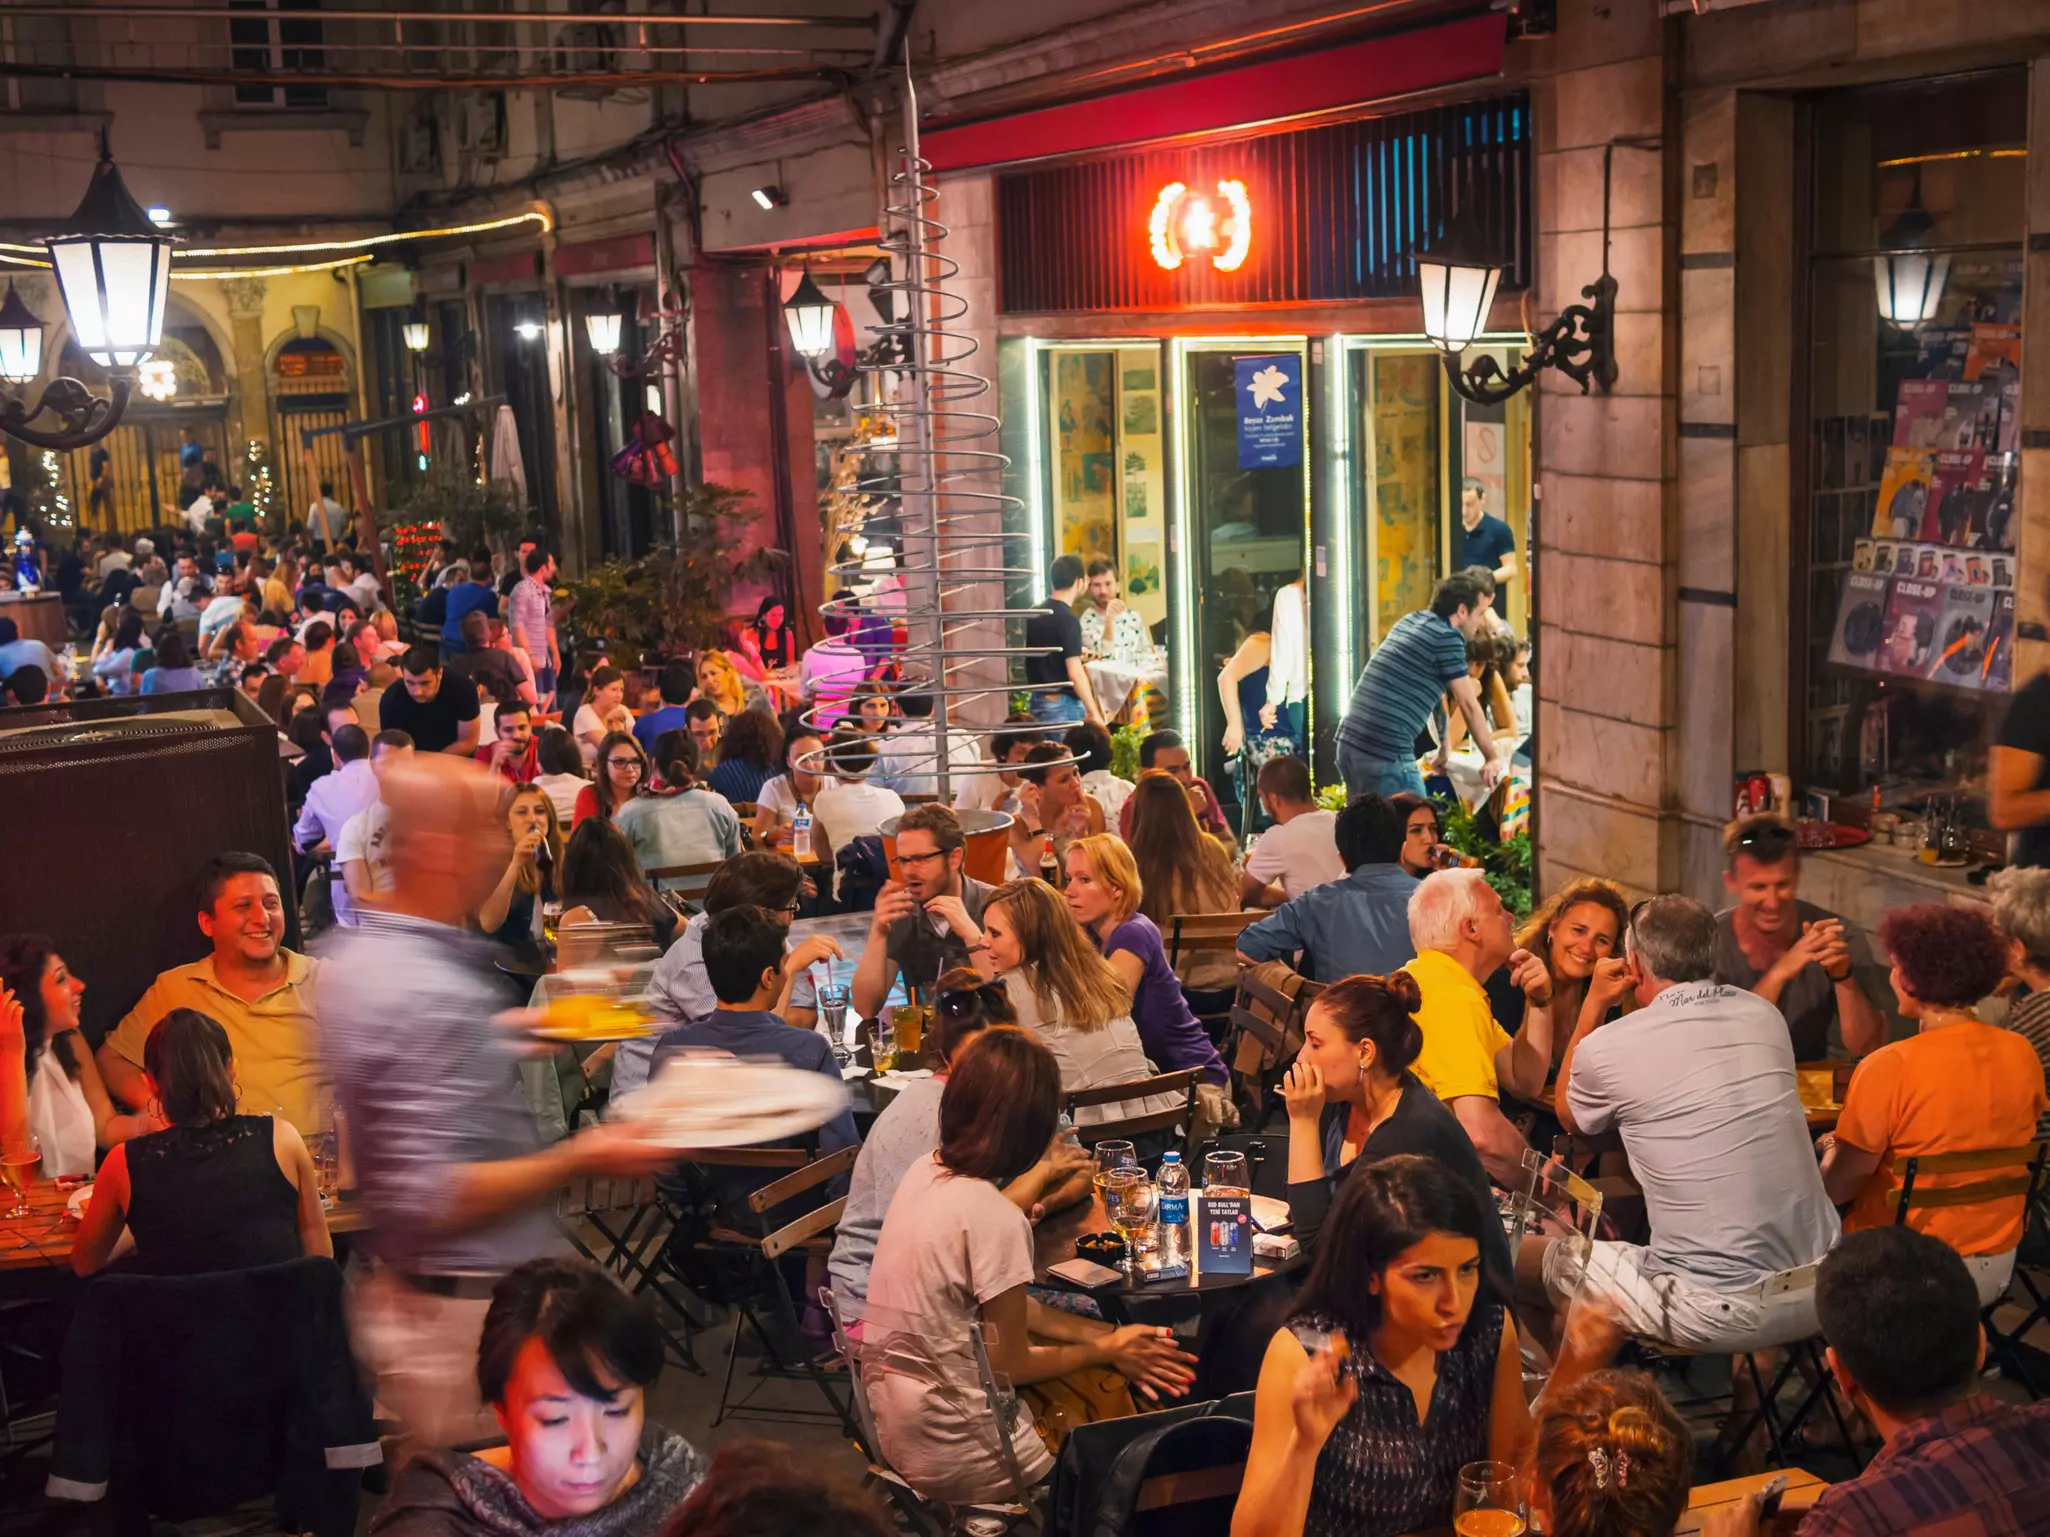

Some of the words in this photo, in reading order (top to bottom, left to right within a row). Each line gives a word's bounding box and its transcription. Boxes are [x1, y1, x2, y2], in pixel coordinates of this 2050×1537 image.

[1850, 577, 1884, 590] CLOSE-UP
[1897, 582, 1936, 598] CLOSE-UP
[1697, 988, 1711, 999] del
